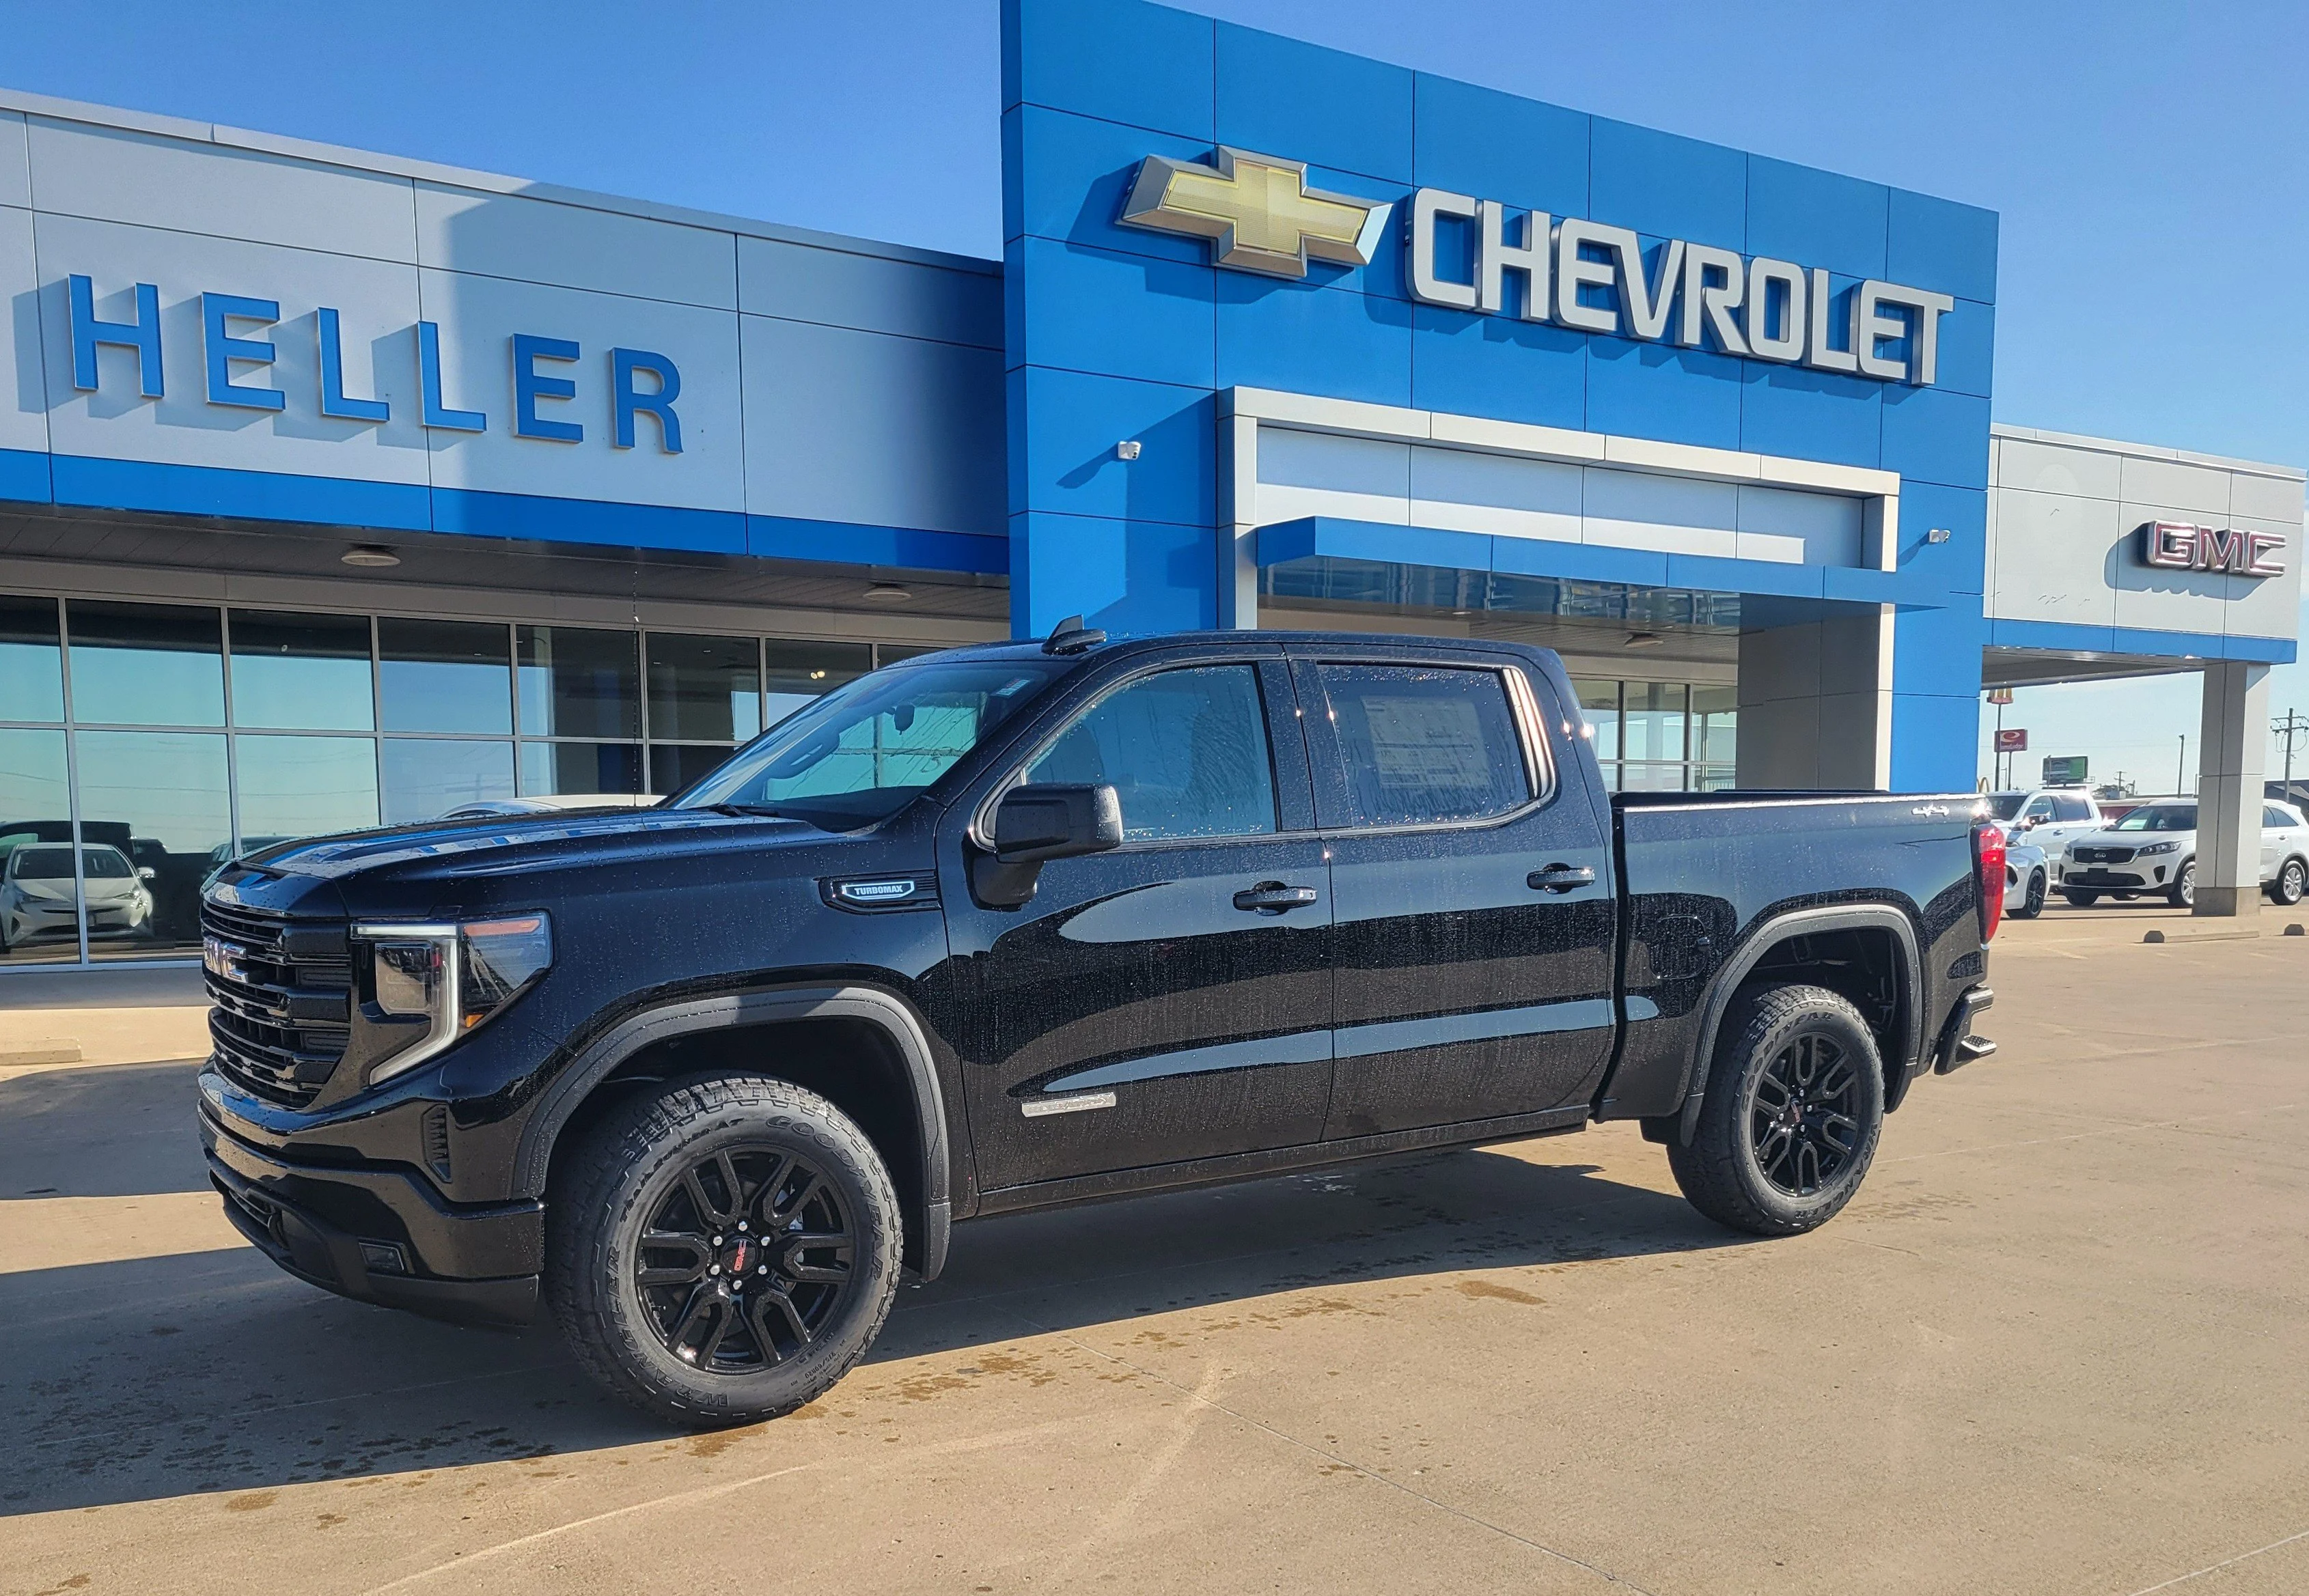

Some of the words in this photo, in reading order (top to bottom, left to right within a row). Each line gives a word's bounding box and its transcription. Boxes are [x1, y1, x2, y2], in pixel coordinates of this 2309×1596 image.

[68, 274, 684, 454] HELLER
[1407, 188, 1954, 385] CHEVROLET
[2149, 519, 2286, 577] GMC
[854, 884, 904, 896] TURBOMAX
[734, 1240, 747, 1271] GMC
[766, 1115, 885, 1280] GOODYEAR
[607, 1246, 728, 1407] WRANGLER
